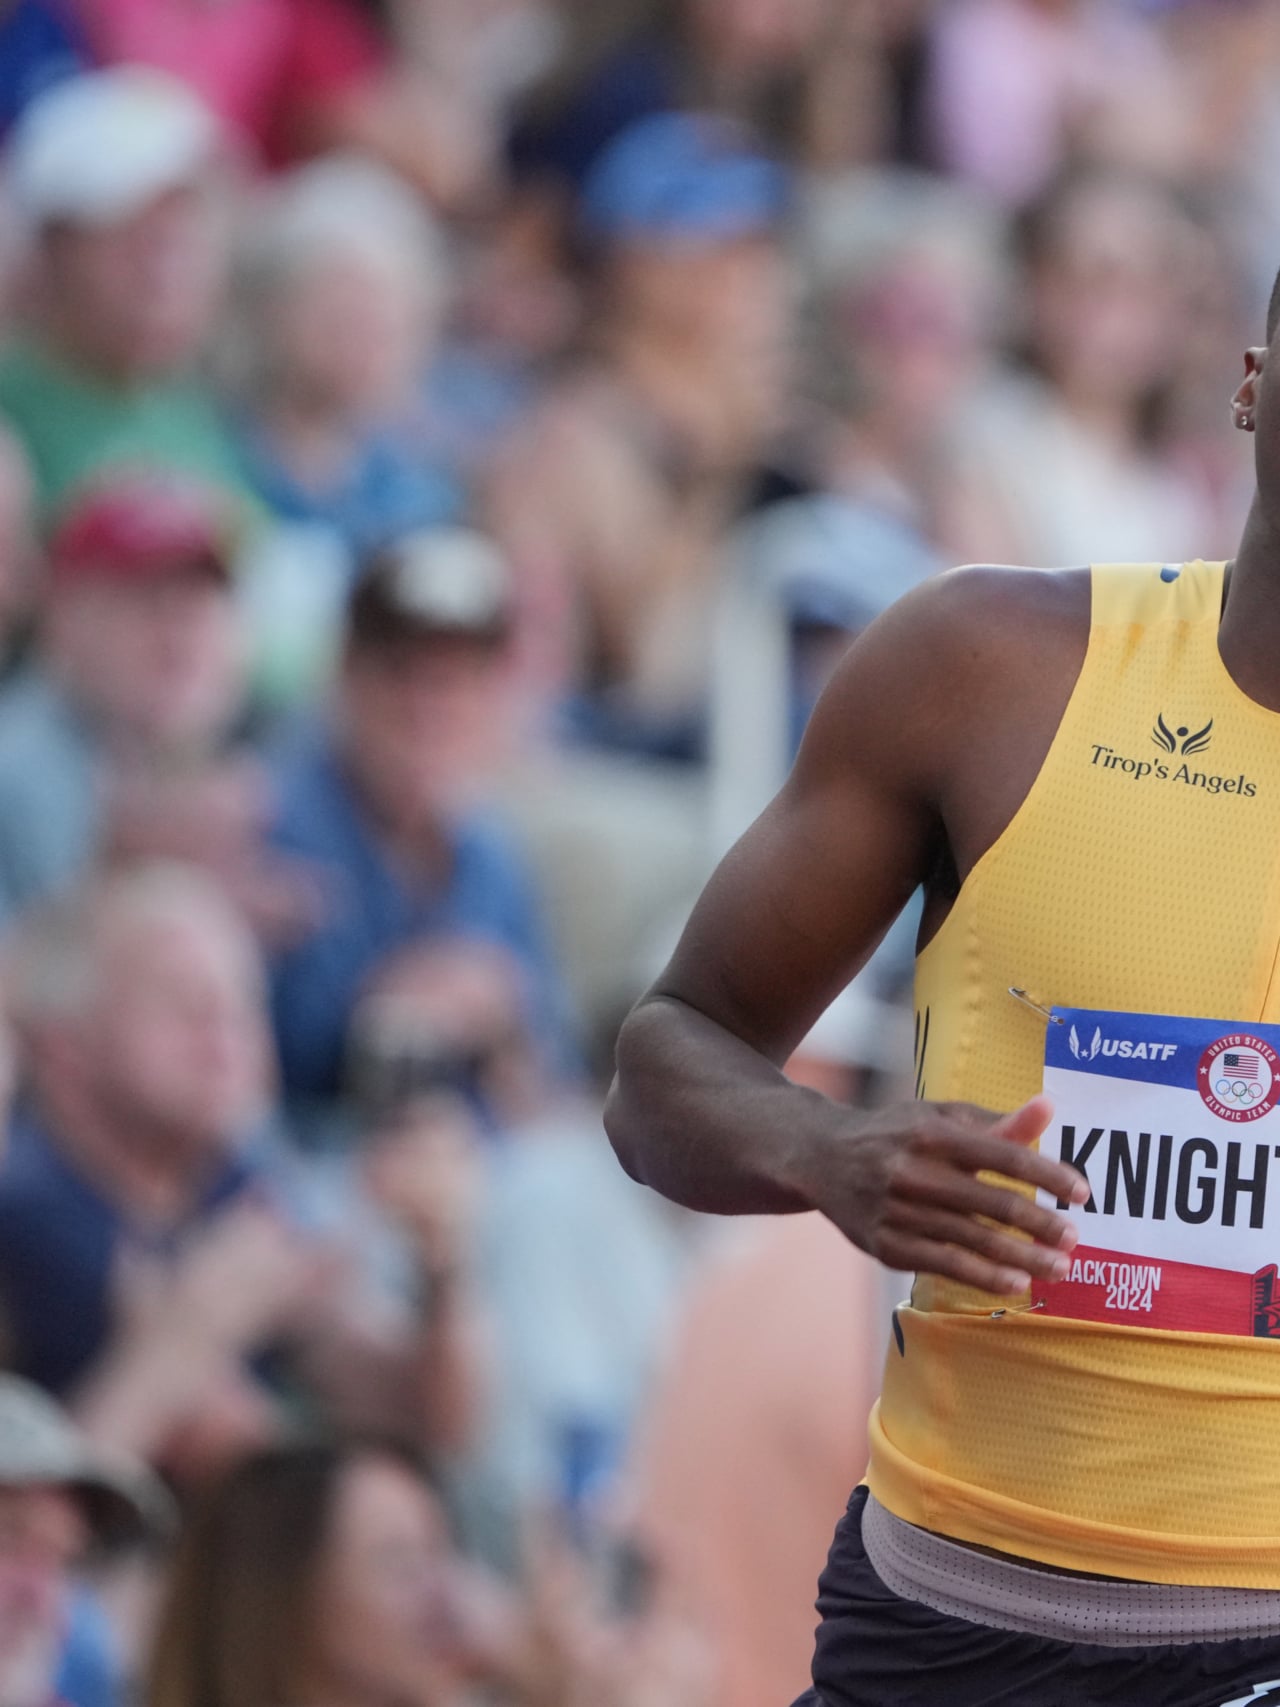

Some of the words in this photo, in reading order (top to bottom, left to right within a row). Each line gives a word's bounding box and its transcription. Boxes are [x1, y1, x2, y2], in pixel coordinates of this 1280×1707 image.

[1091, 744, 1169, 780] Tirop's
[1172, 763, 1257, 798] Angels
[1101, 1039, 1178, 1061] USATF
[1207, 1036, 1241, 1057] UNITED
[1244, 1036, 1277, 1062] STATES
[1204, 1095, 1242, 1121] OLYMPIC
[1246, 1101, 1272, 1120] TEAM
[1062, 1258, 1162, 1291] ACKTOWN
[1105, 1284, 1153, 1312] 2024
